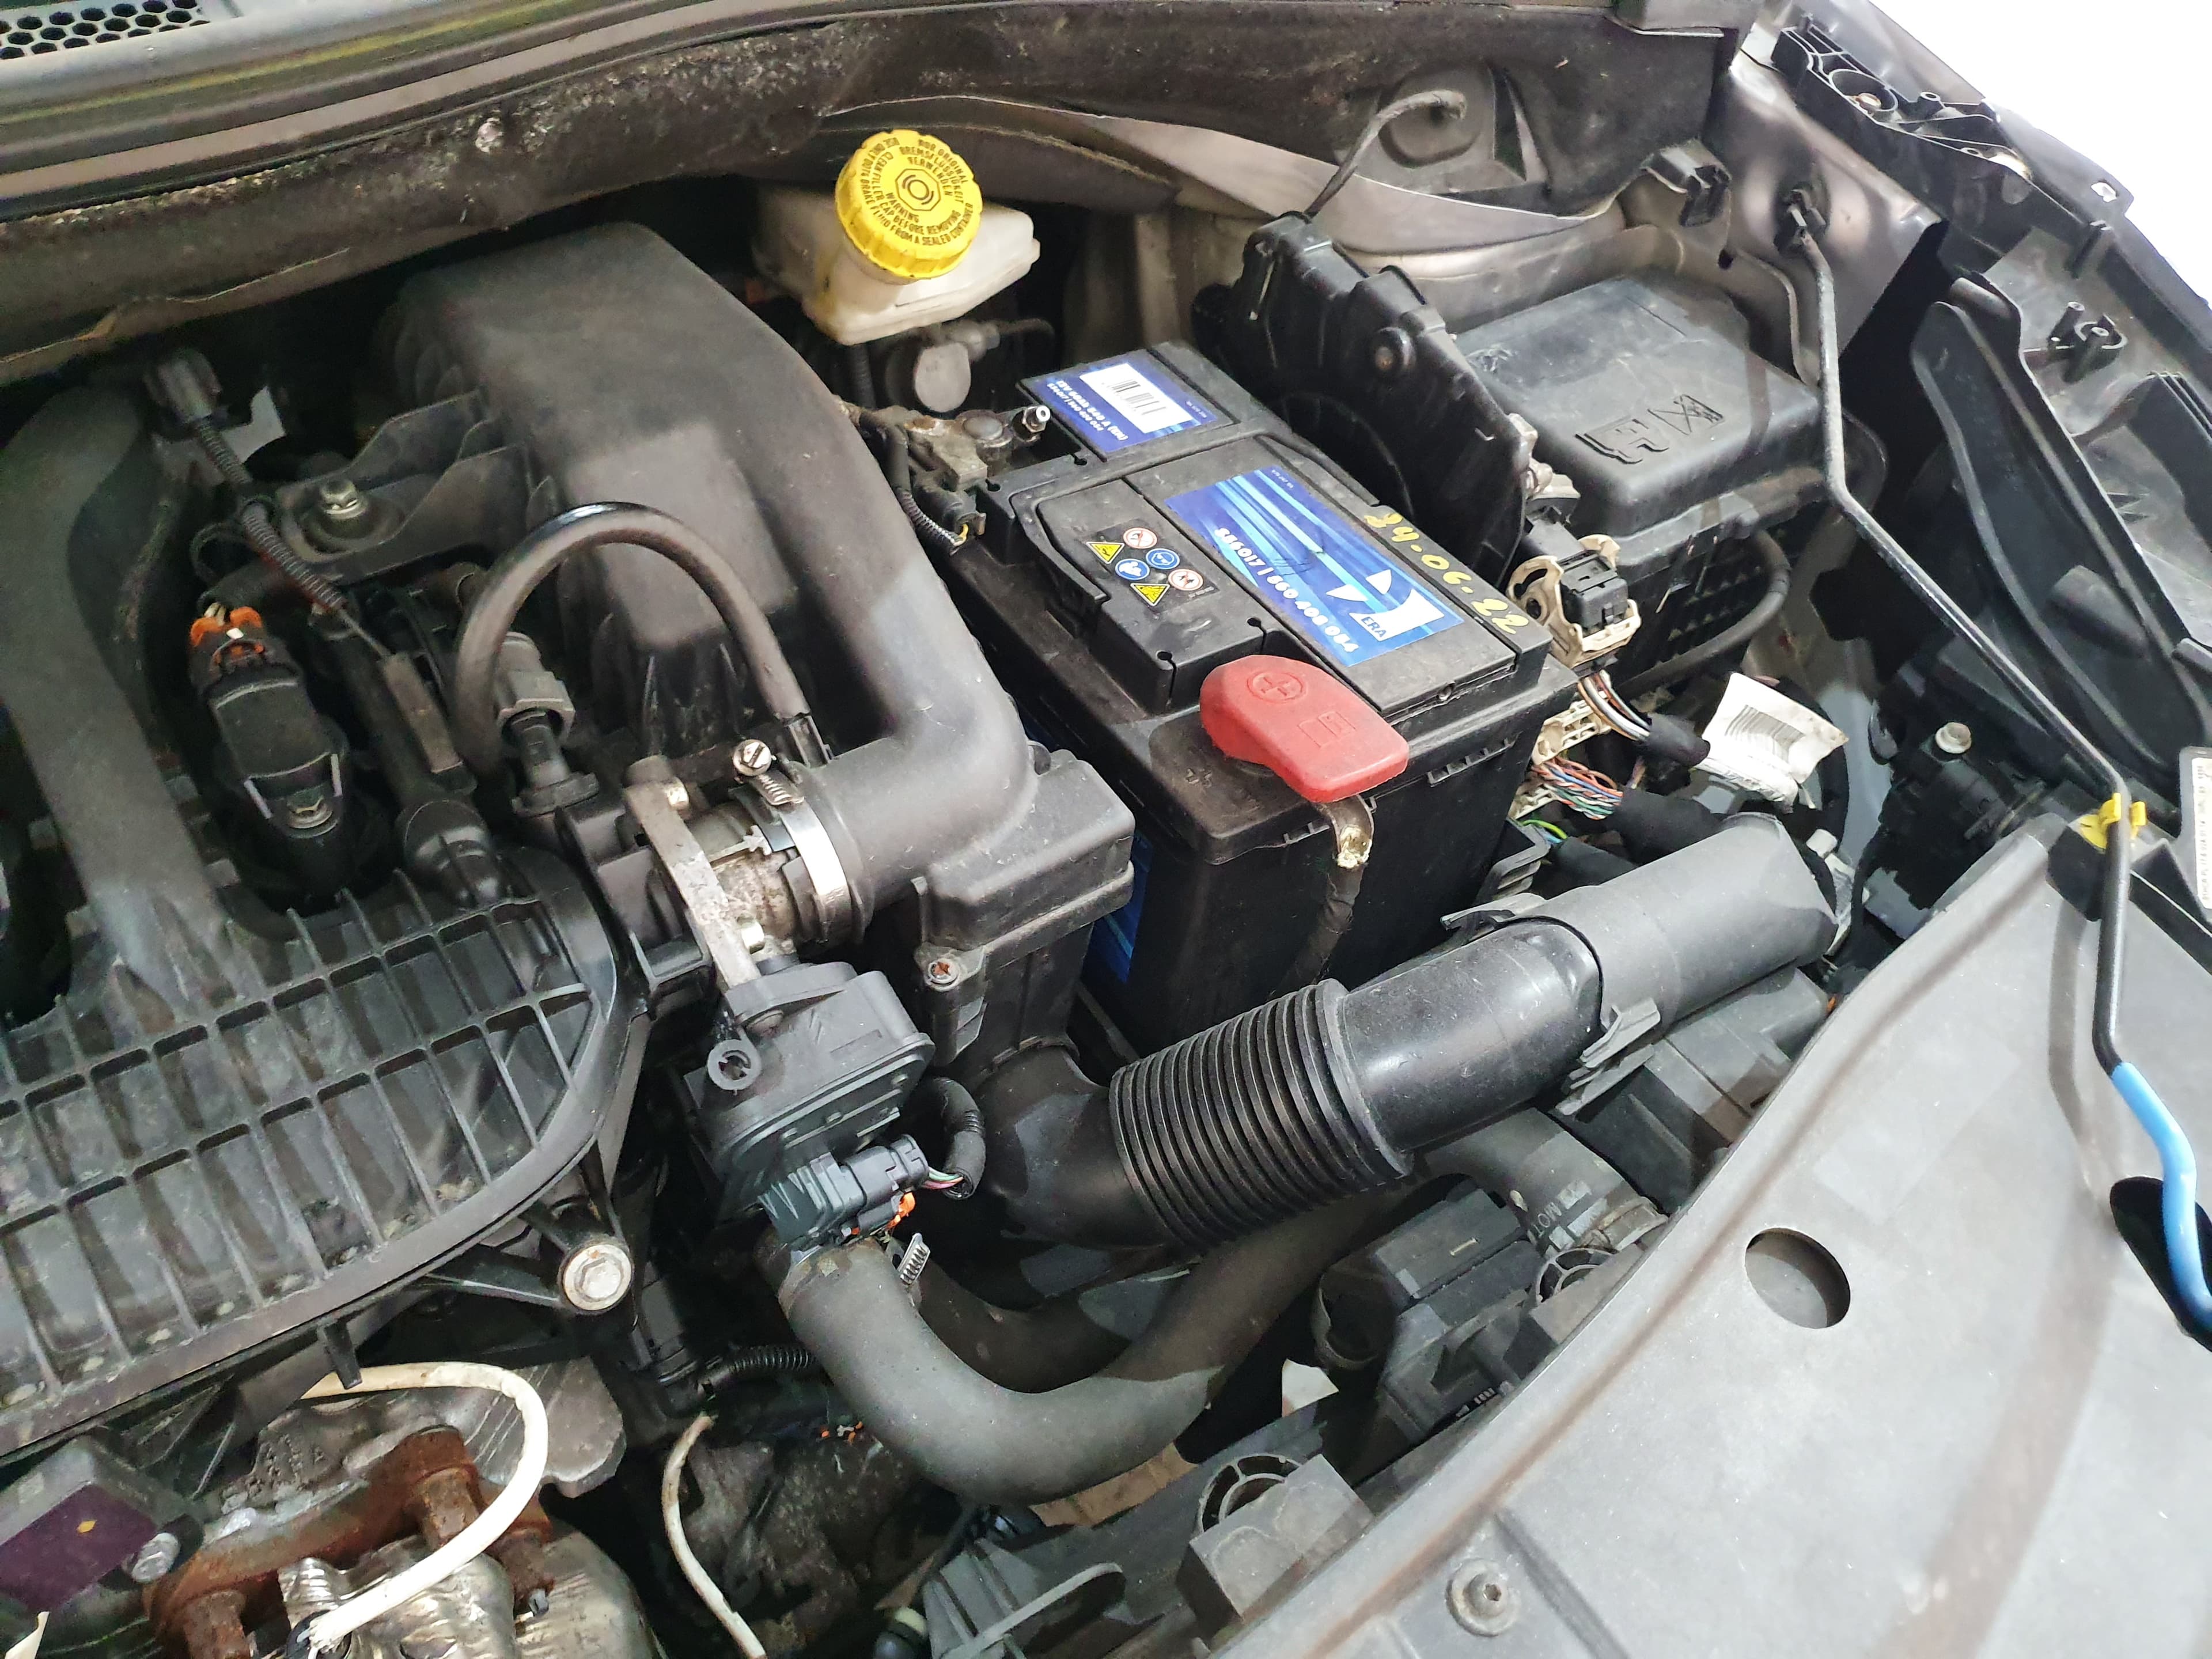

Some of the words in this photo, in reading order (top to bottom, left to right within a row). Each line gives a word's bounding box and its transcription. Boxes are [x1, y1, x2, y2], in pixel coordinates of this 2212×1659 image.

[938, 149, 968, 183] ORIGINAL
[860, 179, 875, 204] BRAKE
[914, 236, 919, 244] A
[922, 233, 950, 245] SEALED
[872, 172, 884, 200] FILLER
[880, 202, 894, 215] CAP
[893, 215, 924, 234] BEFORE
[926, 210, 961, 234] REMOVING
[885, 192, 919, 222] WARNING
[1267, 575, 1298, 598] 560
[1324, 625, 1358, 652] 054
[1361, 616, 1387, 637] ERA
